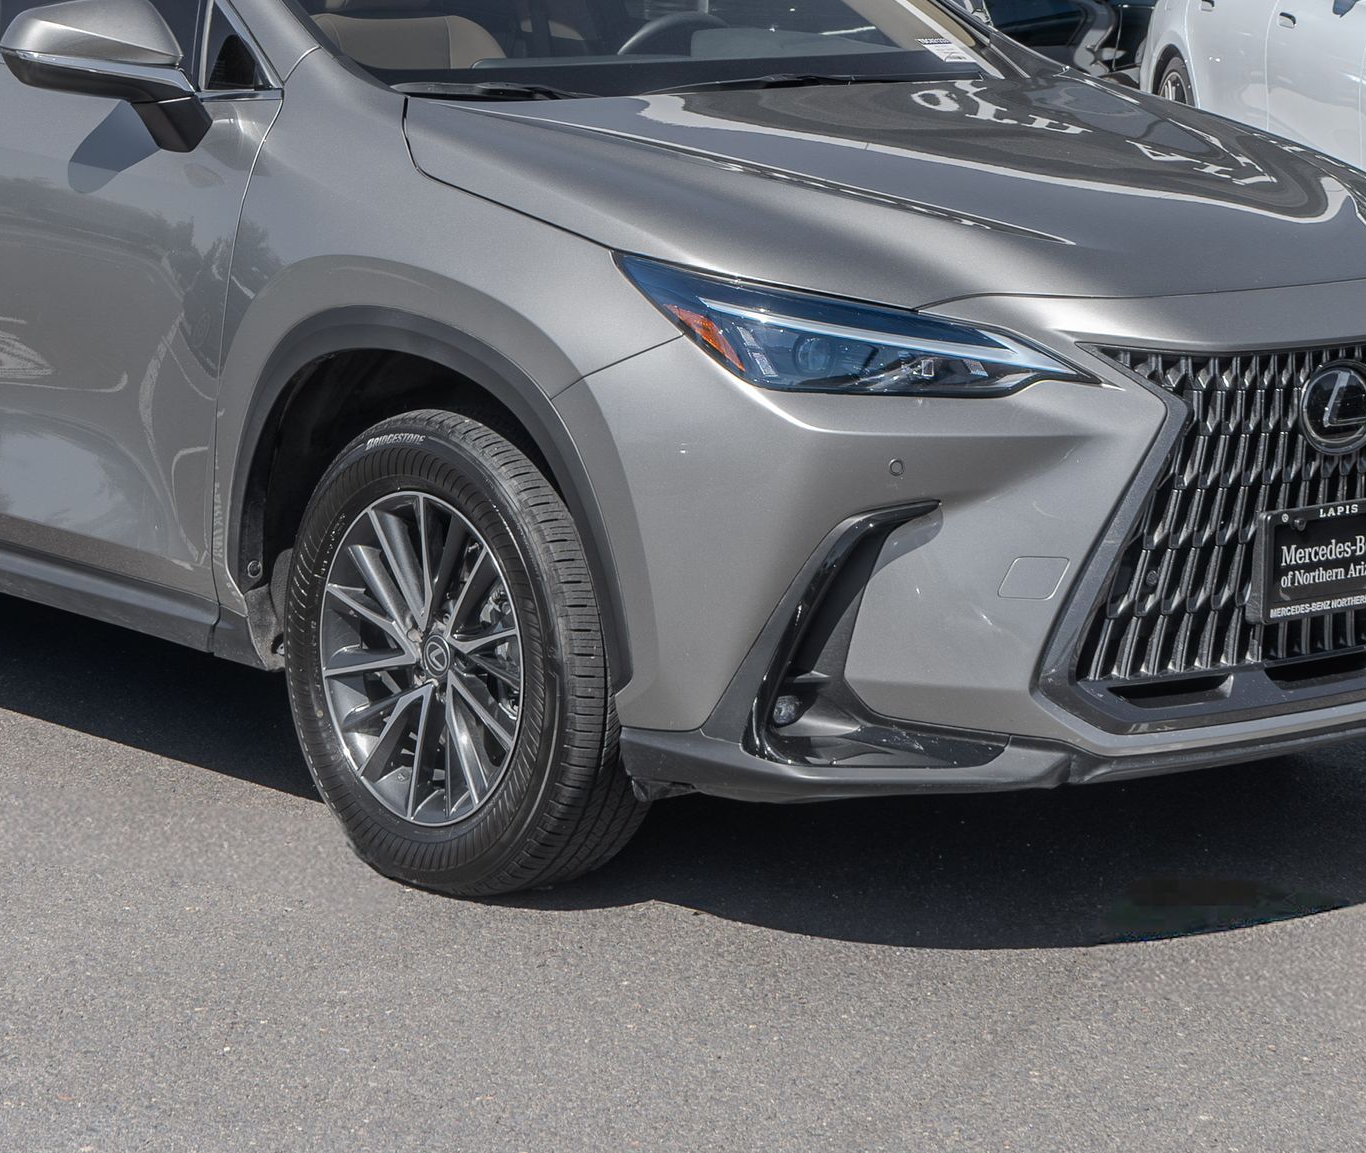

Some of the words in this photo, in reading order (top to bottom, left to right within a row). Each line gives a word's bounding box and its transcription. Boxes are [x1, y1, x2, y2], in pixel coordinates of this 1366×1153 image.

[365, 432, 426, 451] BRIDGESTONE
[1319, 504, 1359, 518] LAPIS
[1280, 571, 1295, 589] of
[1295, 565, 1345, 586] Northern
[1270, 599, 1331, 619] MERCEDES-BENZ
